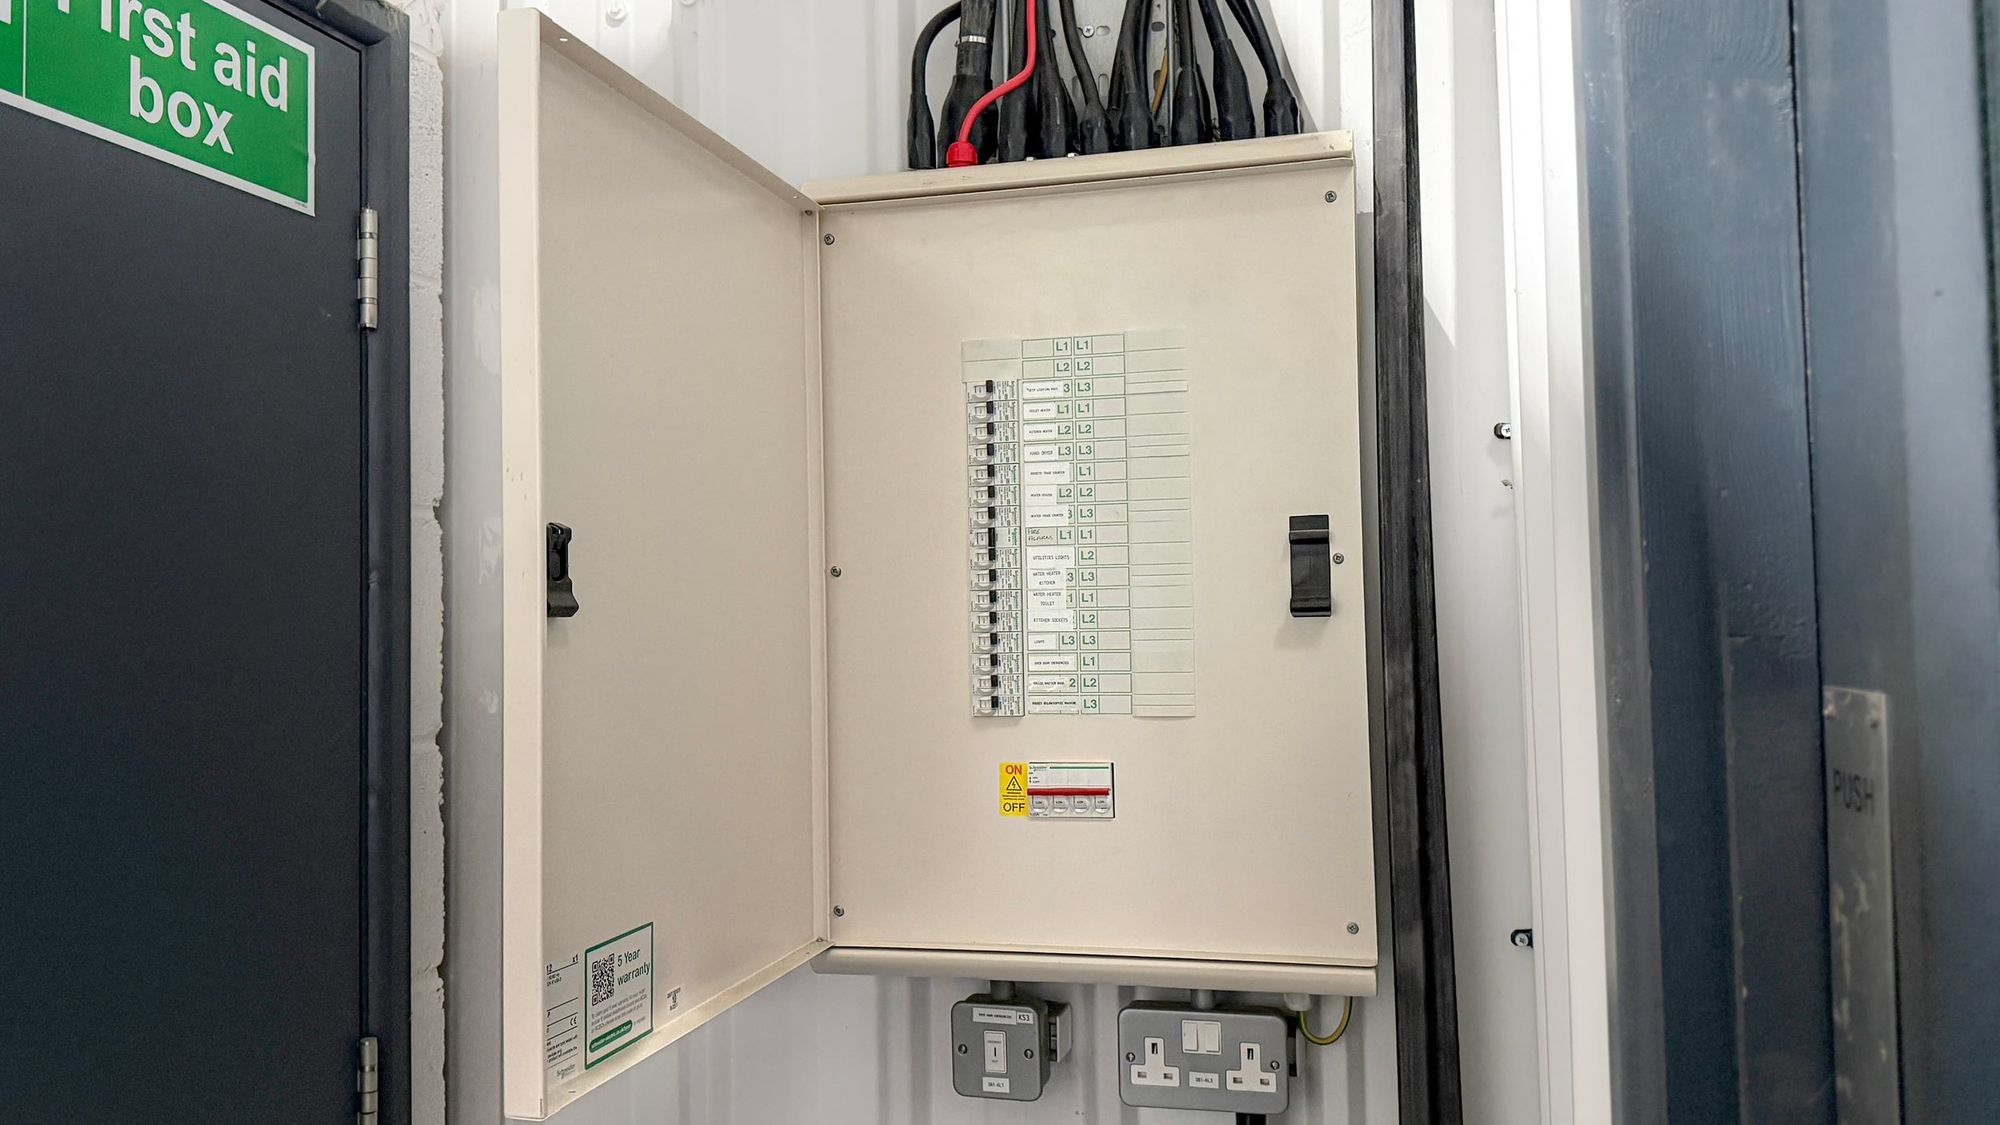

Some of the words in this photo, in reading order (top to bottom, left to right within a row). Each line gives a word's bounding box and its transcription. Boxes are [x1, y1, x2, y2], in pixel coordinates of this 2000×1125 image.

[57, 0, 196, 70] irst
[213, 40, 288, 112] aid
[130, 54, 234, 154] box
[1056, 341, 1068, 351] L1
[1076, 340, 1088, 350] L1
[1056, 362, 1070, 372] L2
[1077, 361, 1090, 371] L2
[1077, 382, 1091, 392] L3
[1057, 404, 1069, 414] L1
[1078, 403, 1090, 412] L1
[1058, 425, 1071, 435] L2
[1078, 424, 1092, 434] L2
[1058, 446, 1071, 456] L3
[1079, 445, 1092, 455] L3
[1079, 466, 1091, 476] L1
[1059, 489, 1072, 498] L2
[1080, 488, 1093, 497] L2
[1080, 509, 1093, 518] L3
[1060, 530, 1072, 540] L1
[1080, 530, 1092, 539] L1
[1081, 551, 1094, 560] L2
[1081, 572, 1094, 581] L3
[1082, 593, 1093, 602] L1
[1082, 614, 1095, 624] L2
[1062, 636, 1075, 645] L3
[1083, 635, 1096, 645] L3
[1083, 657, 1095, 666] L1
[1083, 678, 1097, 687] L2
[1084, 699, 1097, 708] L3
[1005, 765, 1022, 775] ON
[1833, 770, 1874, 816] PUSH
[1003, 803, 1025, 812] OFF
[617, 954, 622, 967] 5
[624, 949, 640, 964] Year
[617, 961, 650, 986] warranty
